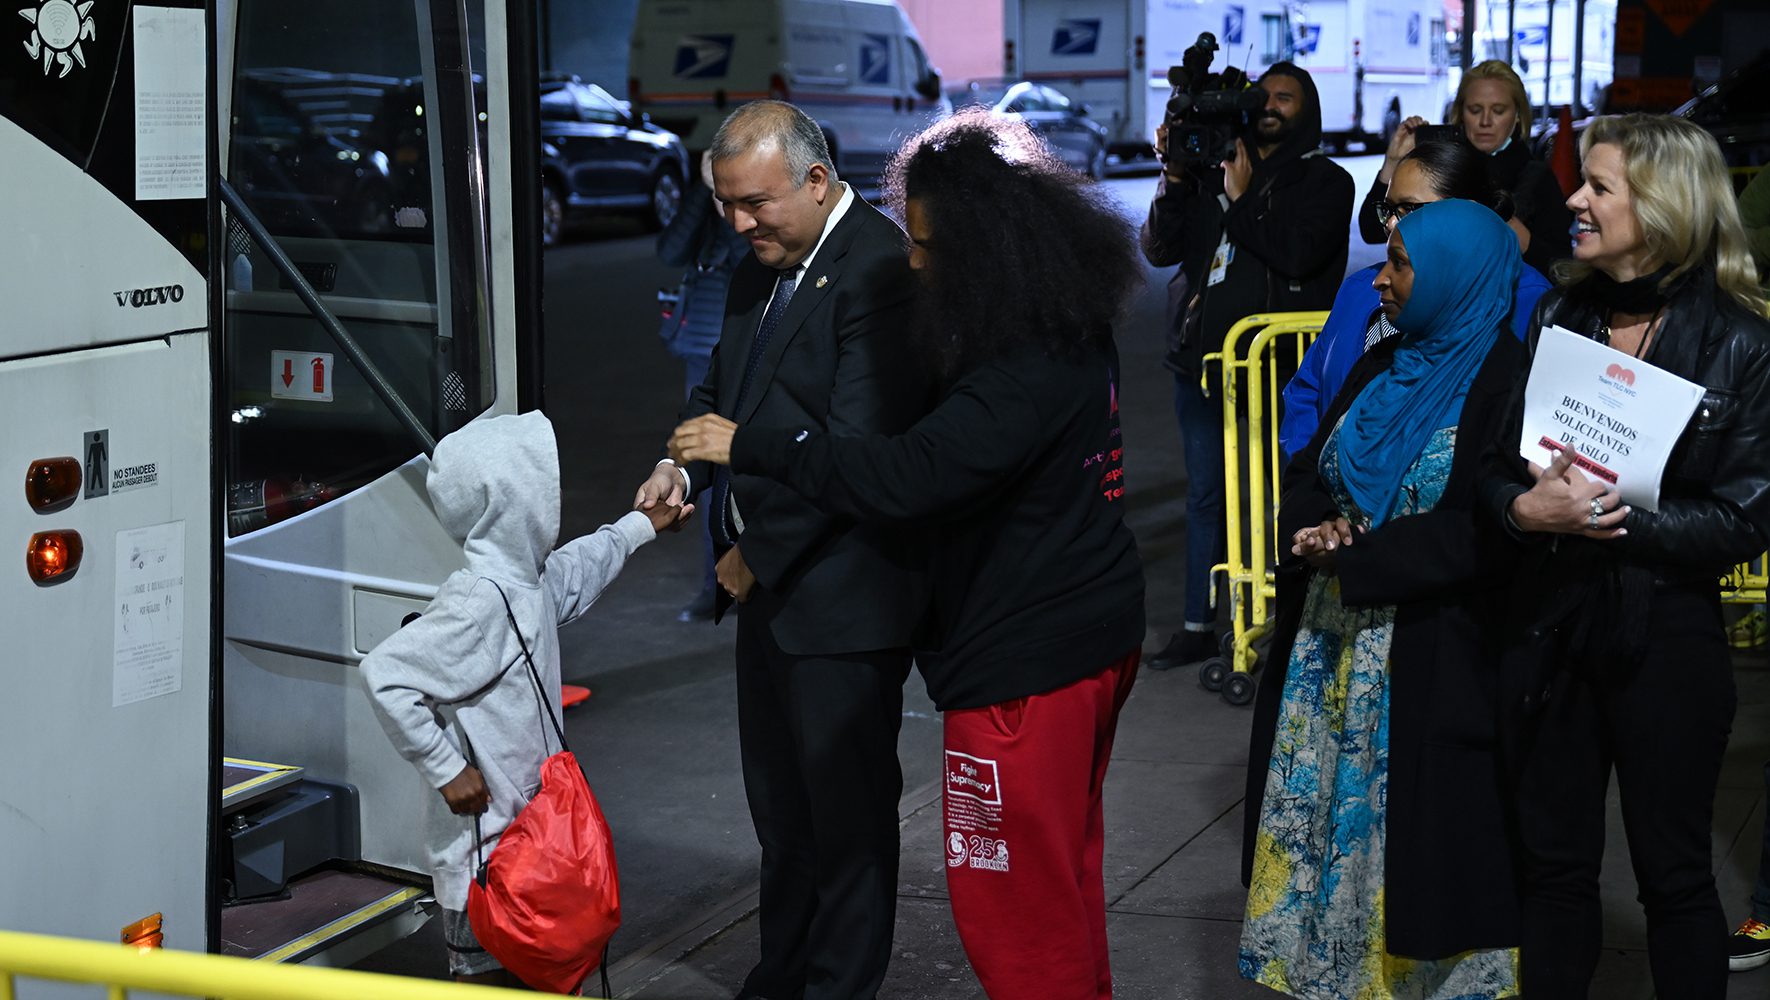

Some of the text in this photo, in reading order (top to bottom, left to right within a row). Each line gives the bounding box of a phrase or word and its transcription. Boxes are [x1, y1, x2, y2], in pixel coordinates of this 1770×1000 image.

[113, 284, 184, 308] VOLVO
[1598, 375, 1637, 398] Team TLC NYC
[1562, 395, 1639, 441] BIENVENIDOS
[1552, 409, 1632, 457] SOLICITANTES
[1560, 432, 1610, 464] DE ASILO
[114, 463, 156, 480] NO STANDEES
[961, 763, 977, 777] Fight
[950, 772, 991, 793] Supremacy
[970, 858, 1008, 870] BROOKLYN
